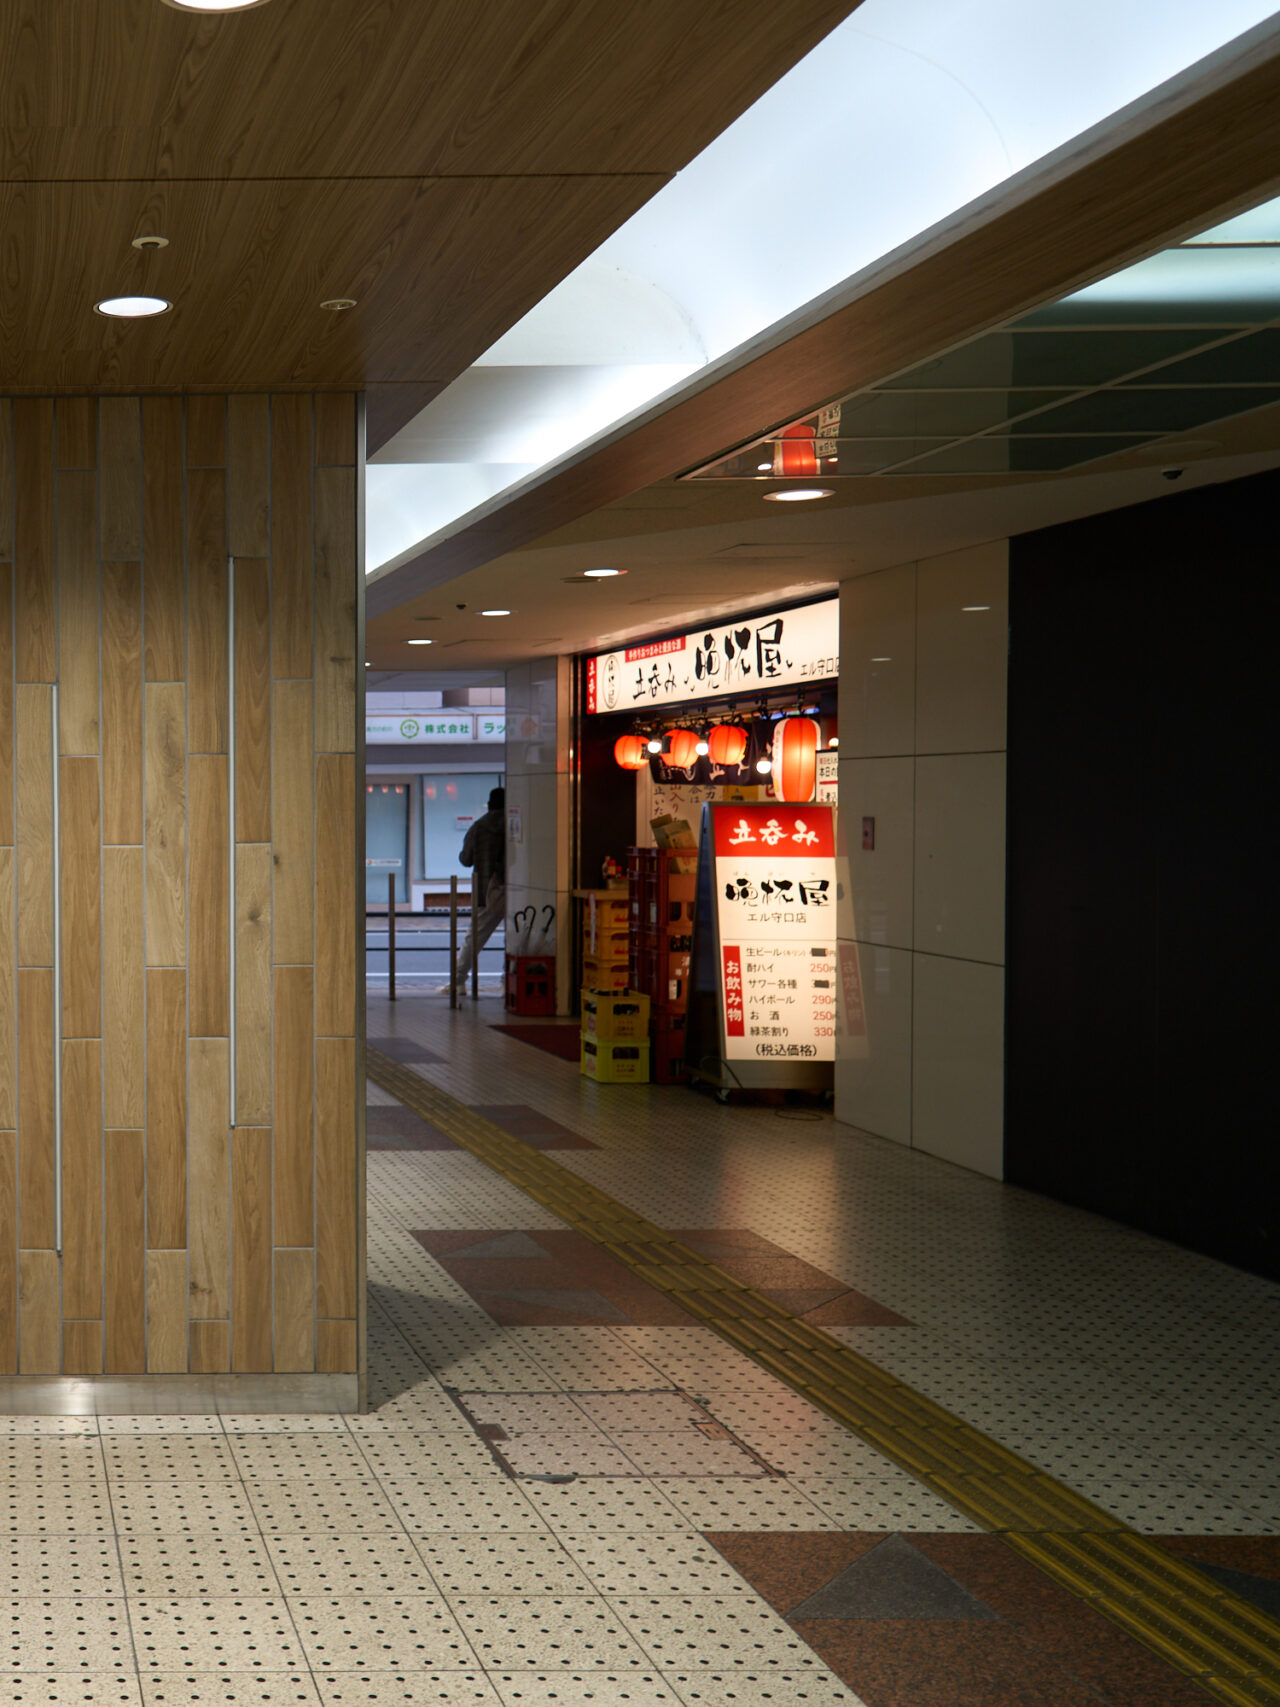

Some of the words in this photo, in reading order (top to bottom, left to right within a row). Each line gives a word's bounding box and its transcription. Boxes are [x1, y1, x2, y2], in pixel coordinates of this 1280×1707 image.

[425, 724, 470, 734] 株式会社
[728, 818, 820, 847] 立呑み
[746, 912, 808, 923] エル守口店
[746, 963, 775, 975] 酎ハイ
[748, 979, 798, 990] サワー各種
[726, 959, 743, 1023] お飲み物
[748, 995, 796, 1006] ハイボール
[749, 1026, 789, 1038] 緑茶割り
[755, 1042, 819, 1058] (税込価格)
